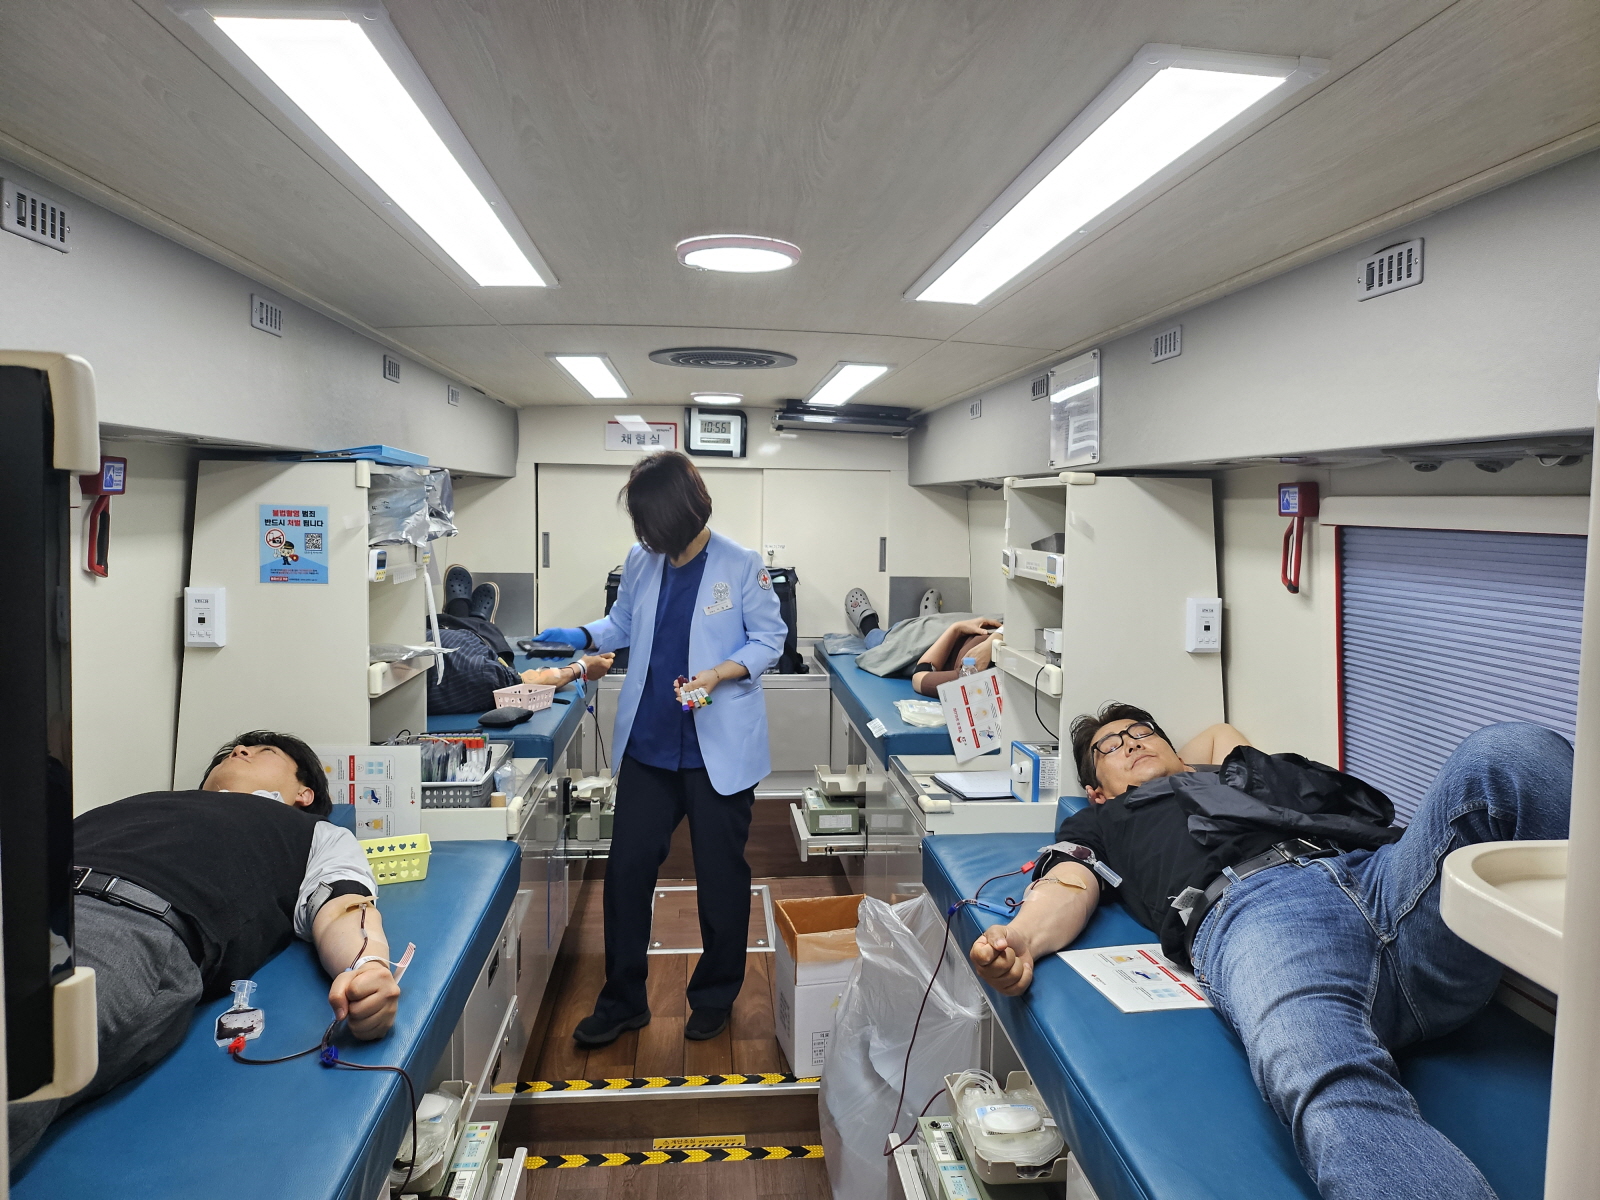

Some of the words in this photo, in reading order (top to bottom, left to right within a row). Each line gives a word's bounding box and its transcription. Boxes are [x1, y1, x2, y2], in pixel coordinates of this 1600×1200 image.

[704, 421, 727, 433] 10:56
[301, 510, 316, 518] 범죄
[264, 518, 285, 526] 반드시
[287, 519, 301, 527] 처벌
[303, 519, 324, 528] 됩니다
